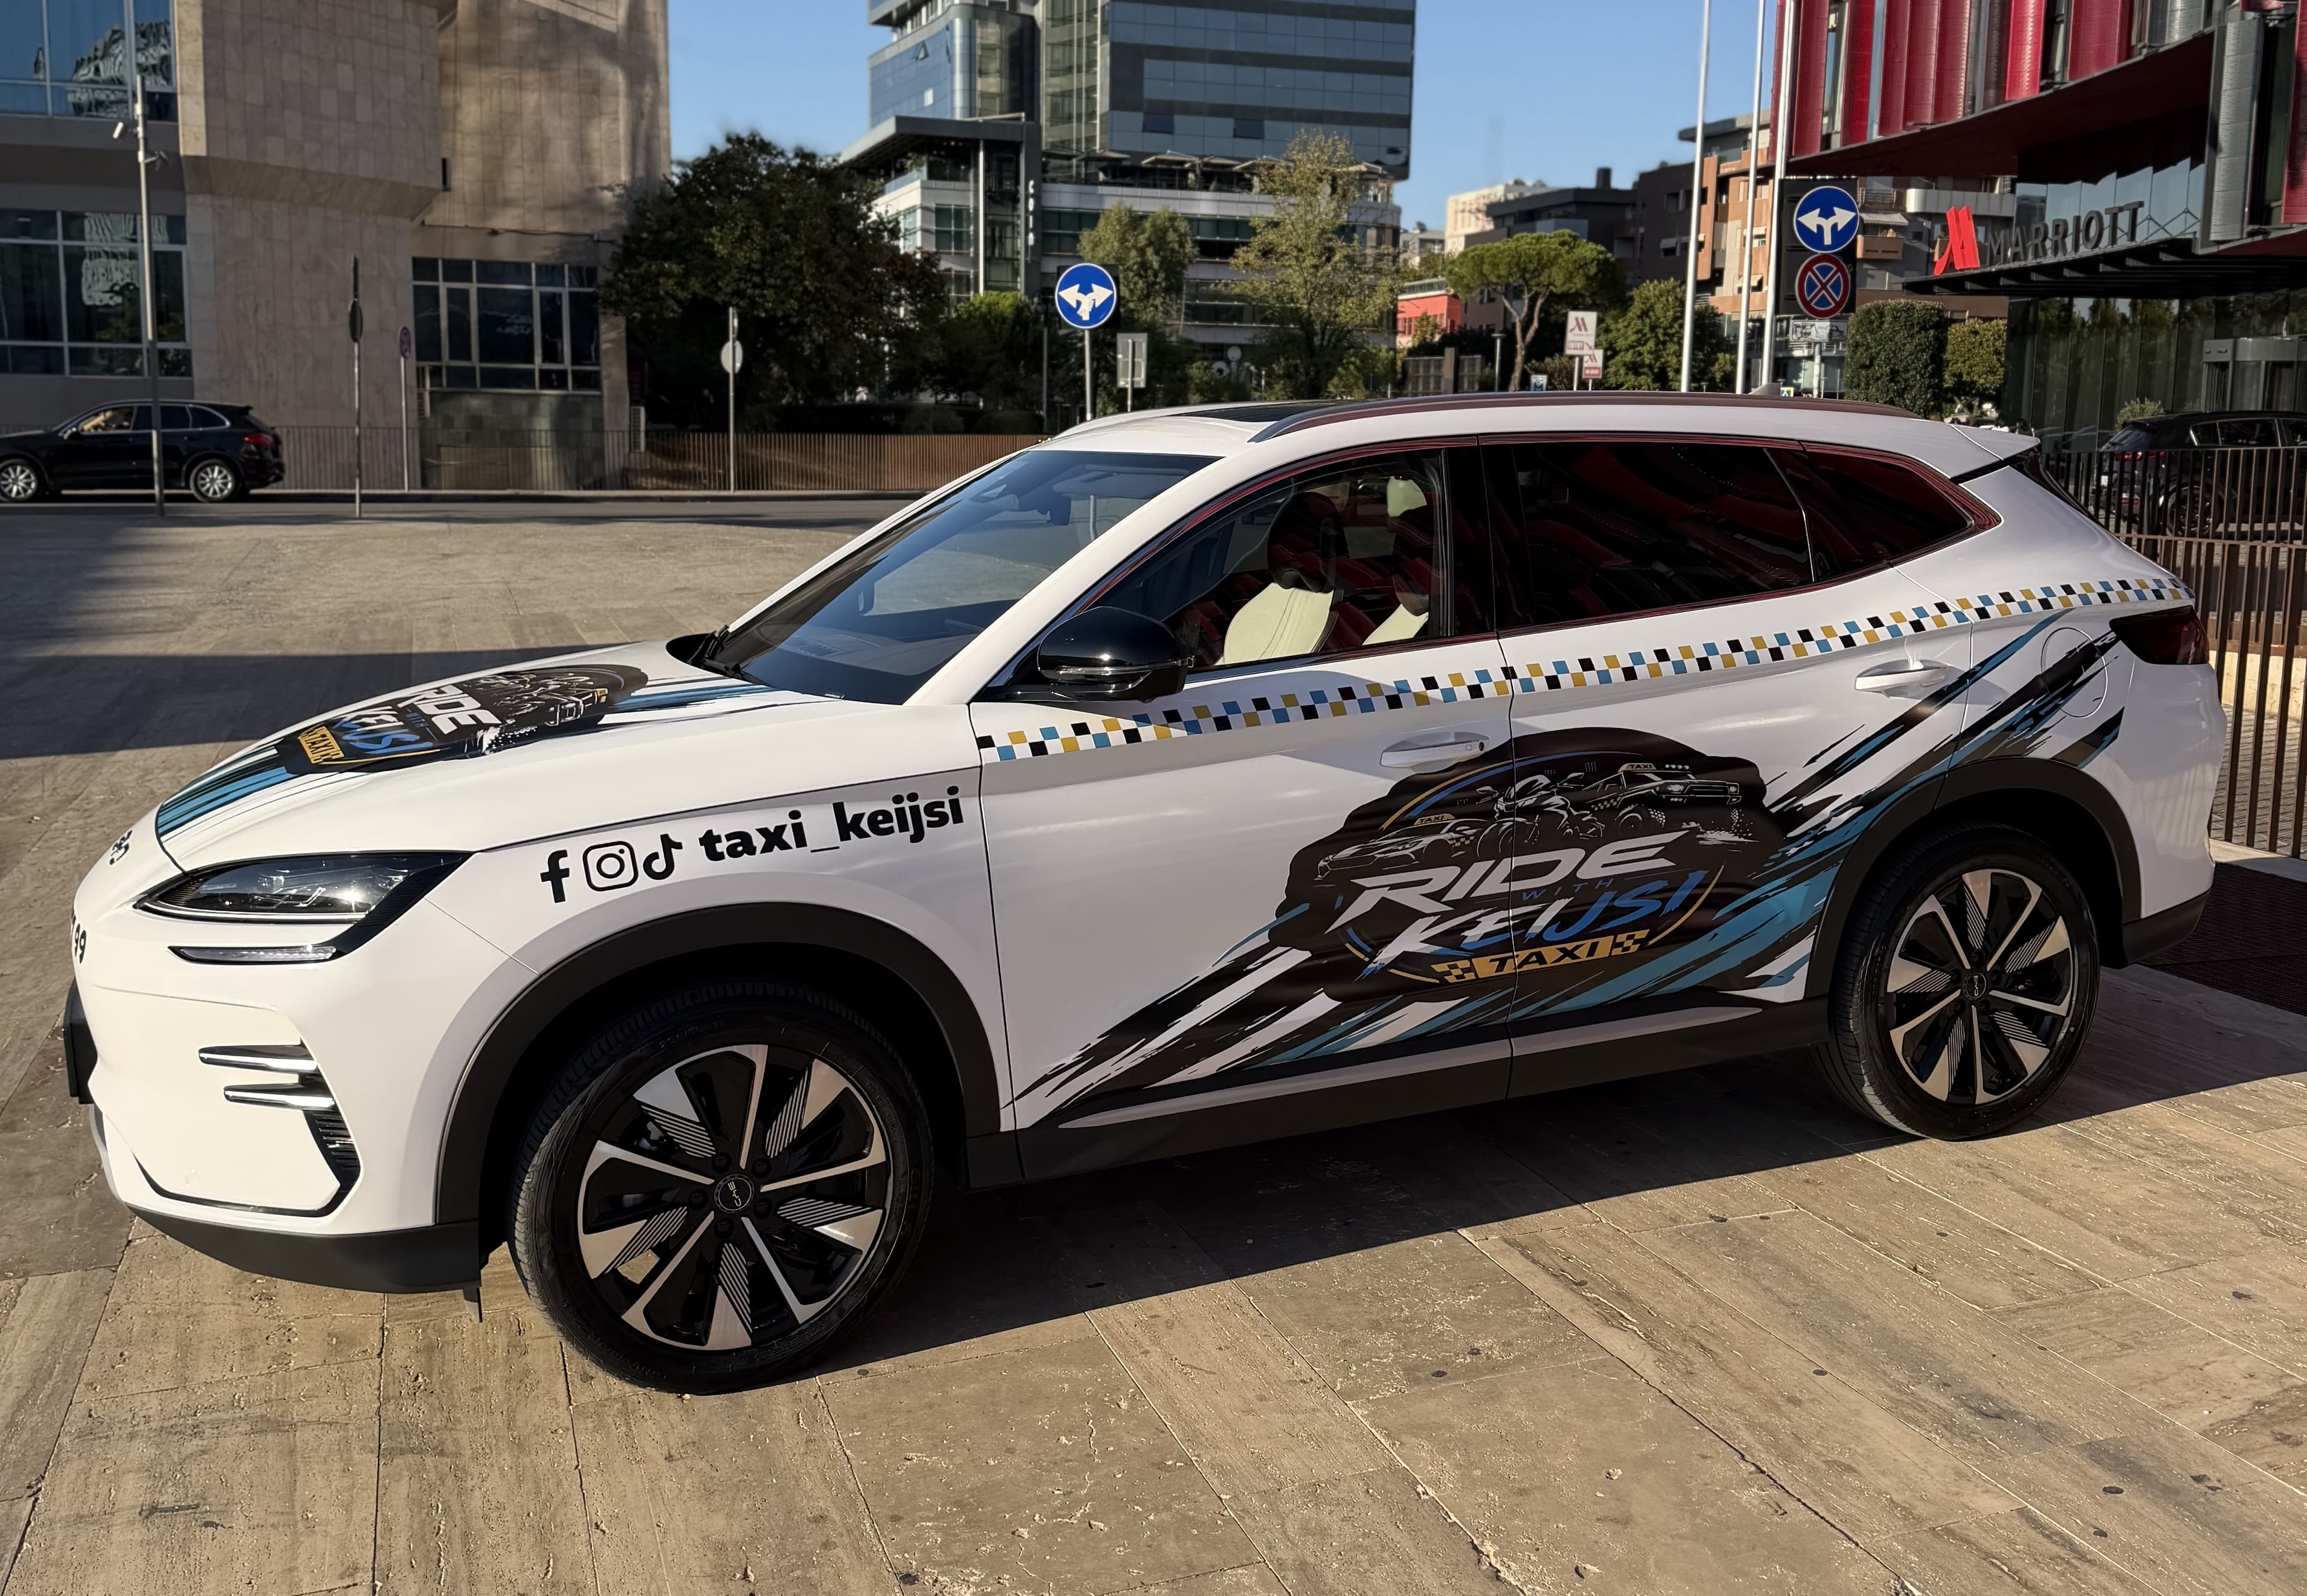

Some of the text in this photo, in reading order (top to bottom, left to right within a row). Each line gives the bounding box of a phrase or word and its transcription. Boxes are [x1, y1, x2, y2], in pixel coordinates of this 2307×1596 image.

[1985, 200, 2145, 266] MARRIOTT
[397, 685, 502, 735] RIDE
[698, 785, 964, 861] taxi_keijsi
[1419, 815, 1445, 824] TAXI
[1324, 830, 1691, 935] RIDE
[1522, 878, 1614, 901] WITH
[1489, 940, 1600, 974] TAXI
[727, 1181, 742, 1207] BYD
